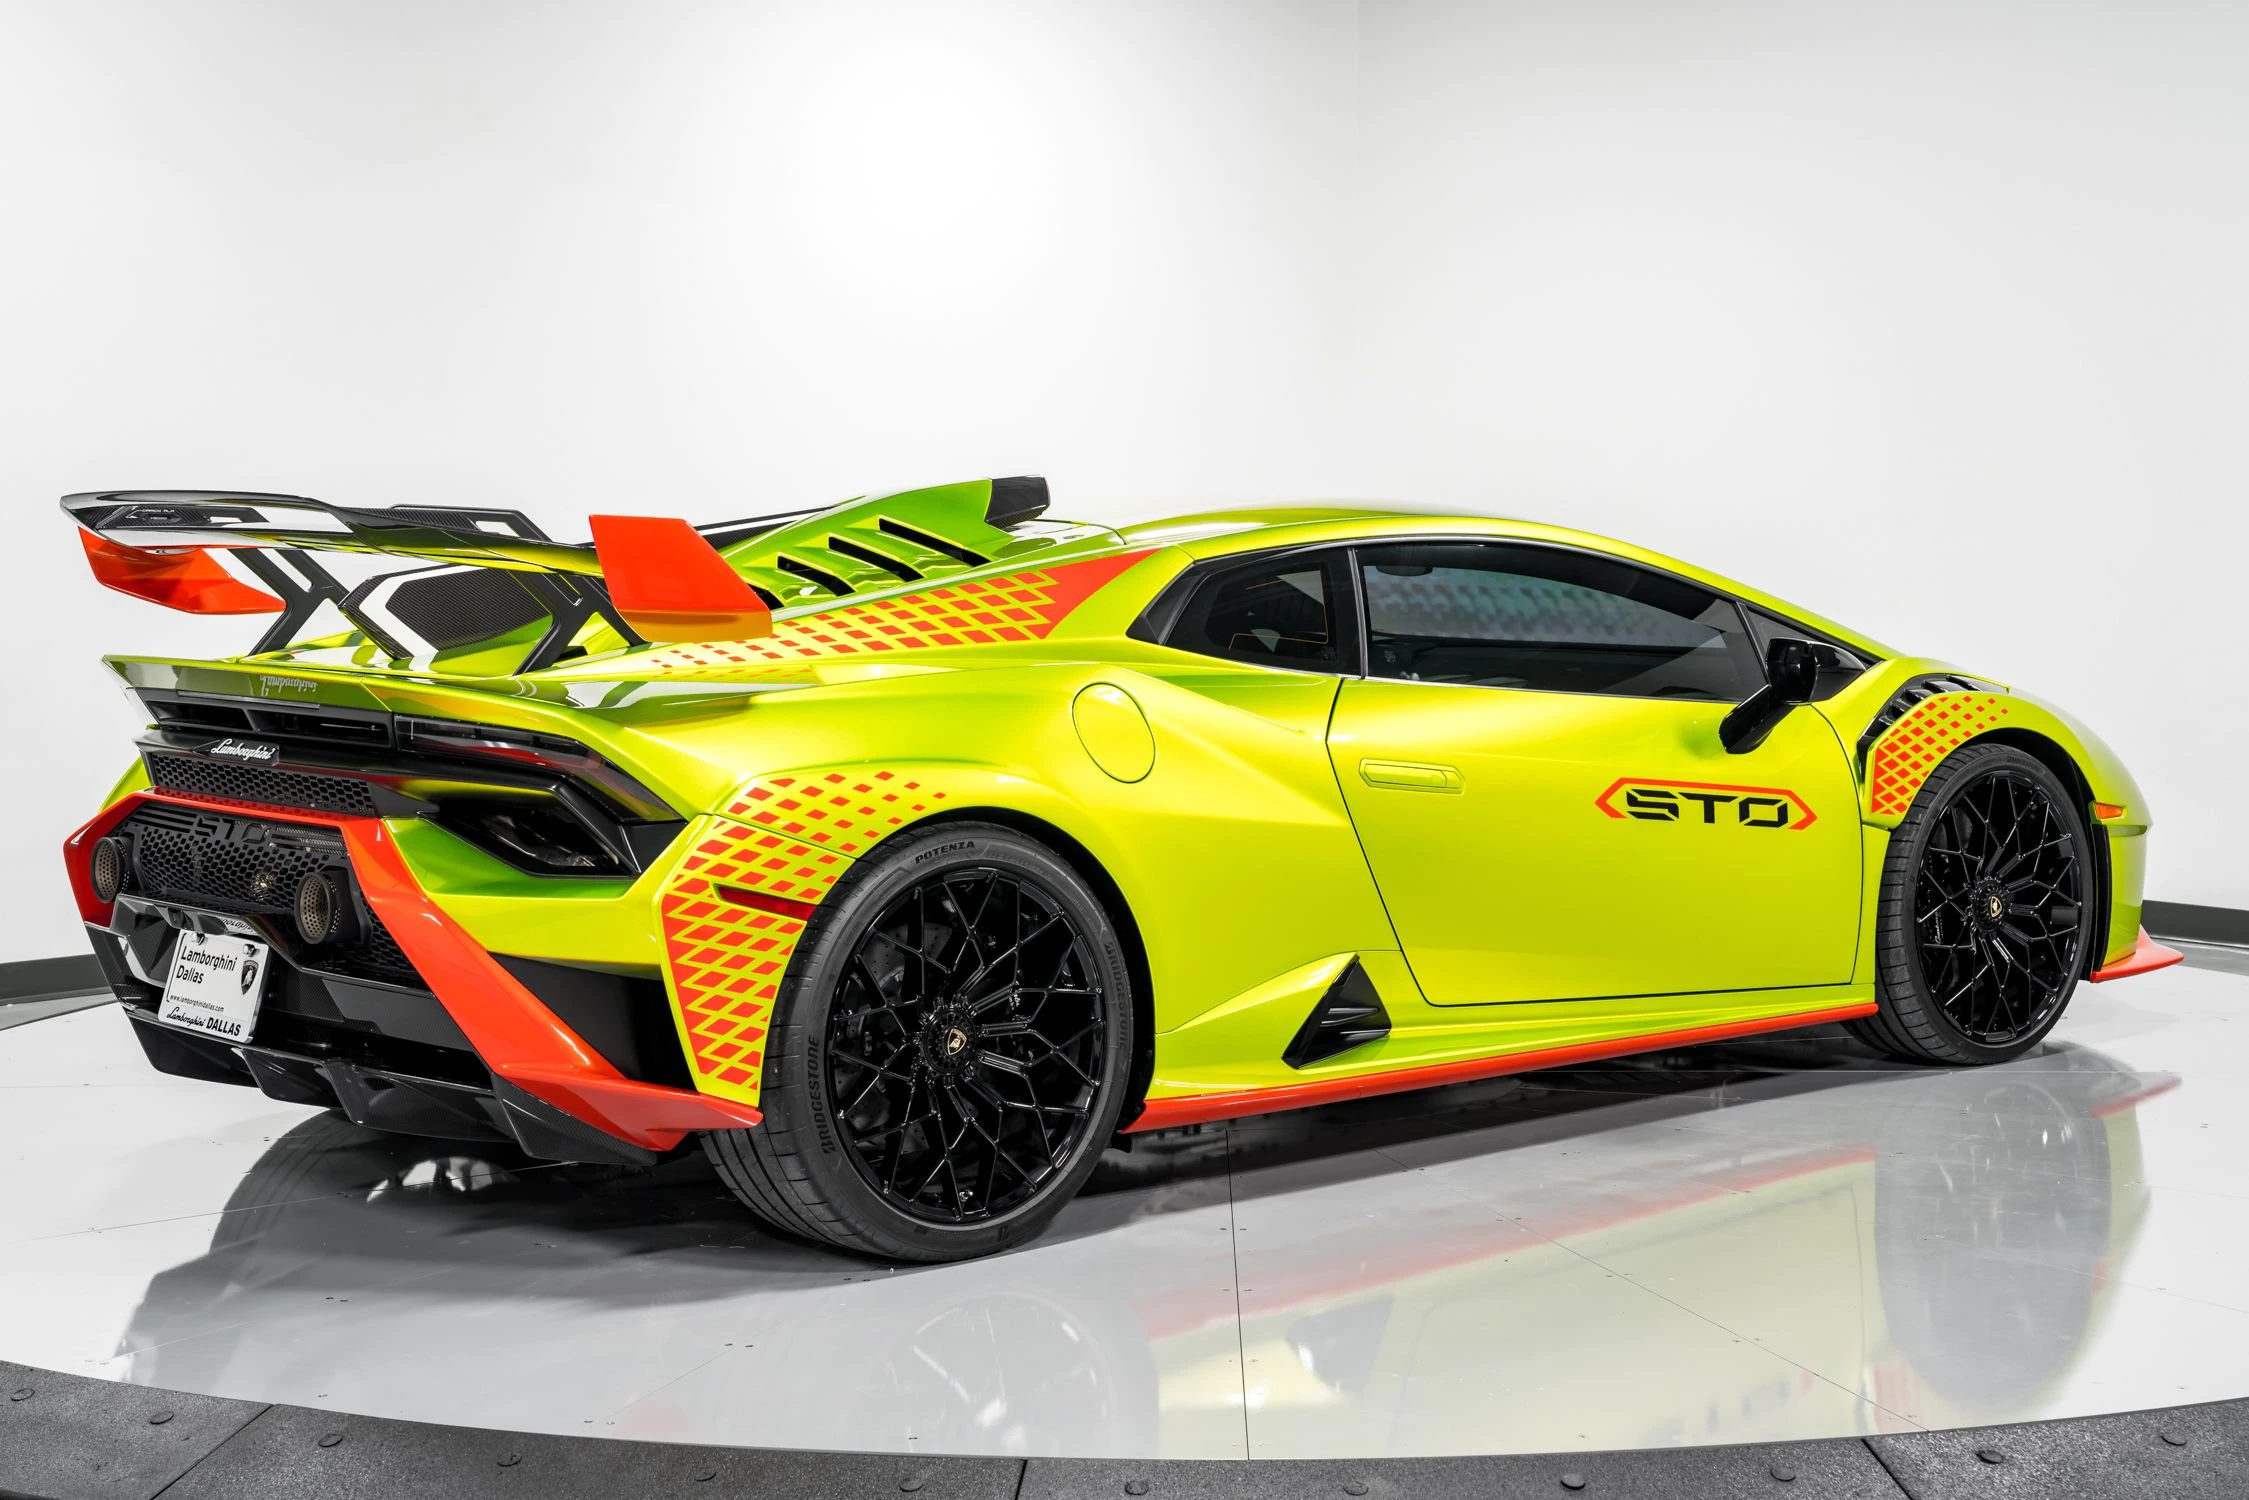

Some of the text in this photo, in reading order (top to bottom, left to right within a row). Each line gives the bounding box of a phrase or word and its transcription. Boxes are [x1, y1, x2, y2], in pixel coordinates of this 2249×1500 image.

[211, 738, 275, 760] Lamborghini
[1626, 788, 1788, 828] STO
[915, 840, 975, 864] POTENZA
[181, 946, 237, 972] Lamborghini
[176, 965, 204, 984] Dallas
[166, 1006, 241, 1036] Lamborghini DALLAS
[808, 1035, 837, 1154] BRIDGESTONE
